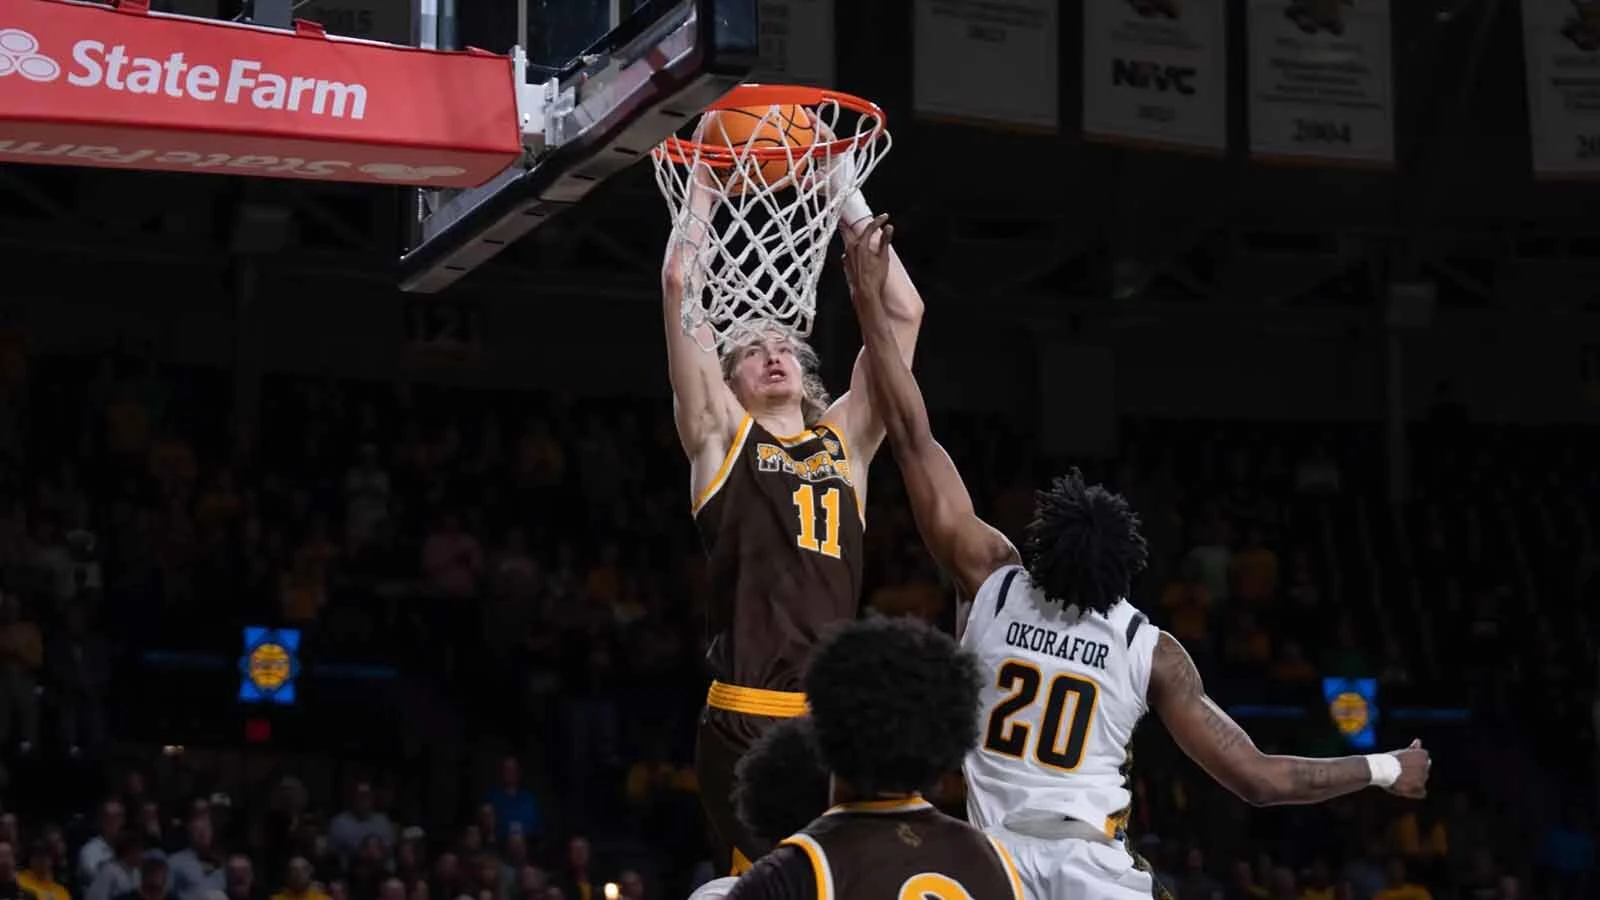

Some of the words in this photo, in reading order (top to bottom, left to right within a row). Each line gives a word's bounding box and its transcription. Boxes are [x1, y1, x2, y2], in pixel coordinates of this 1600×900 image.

[792, 483, 841, 560] 11
[1006, 621, 1110, 670] OKORAFOR
[983, 657, 1099, 773] 20
